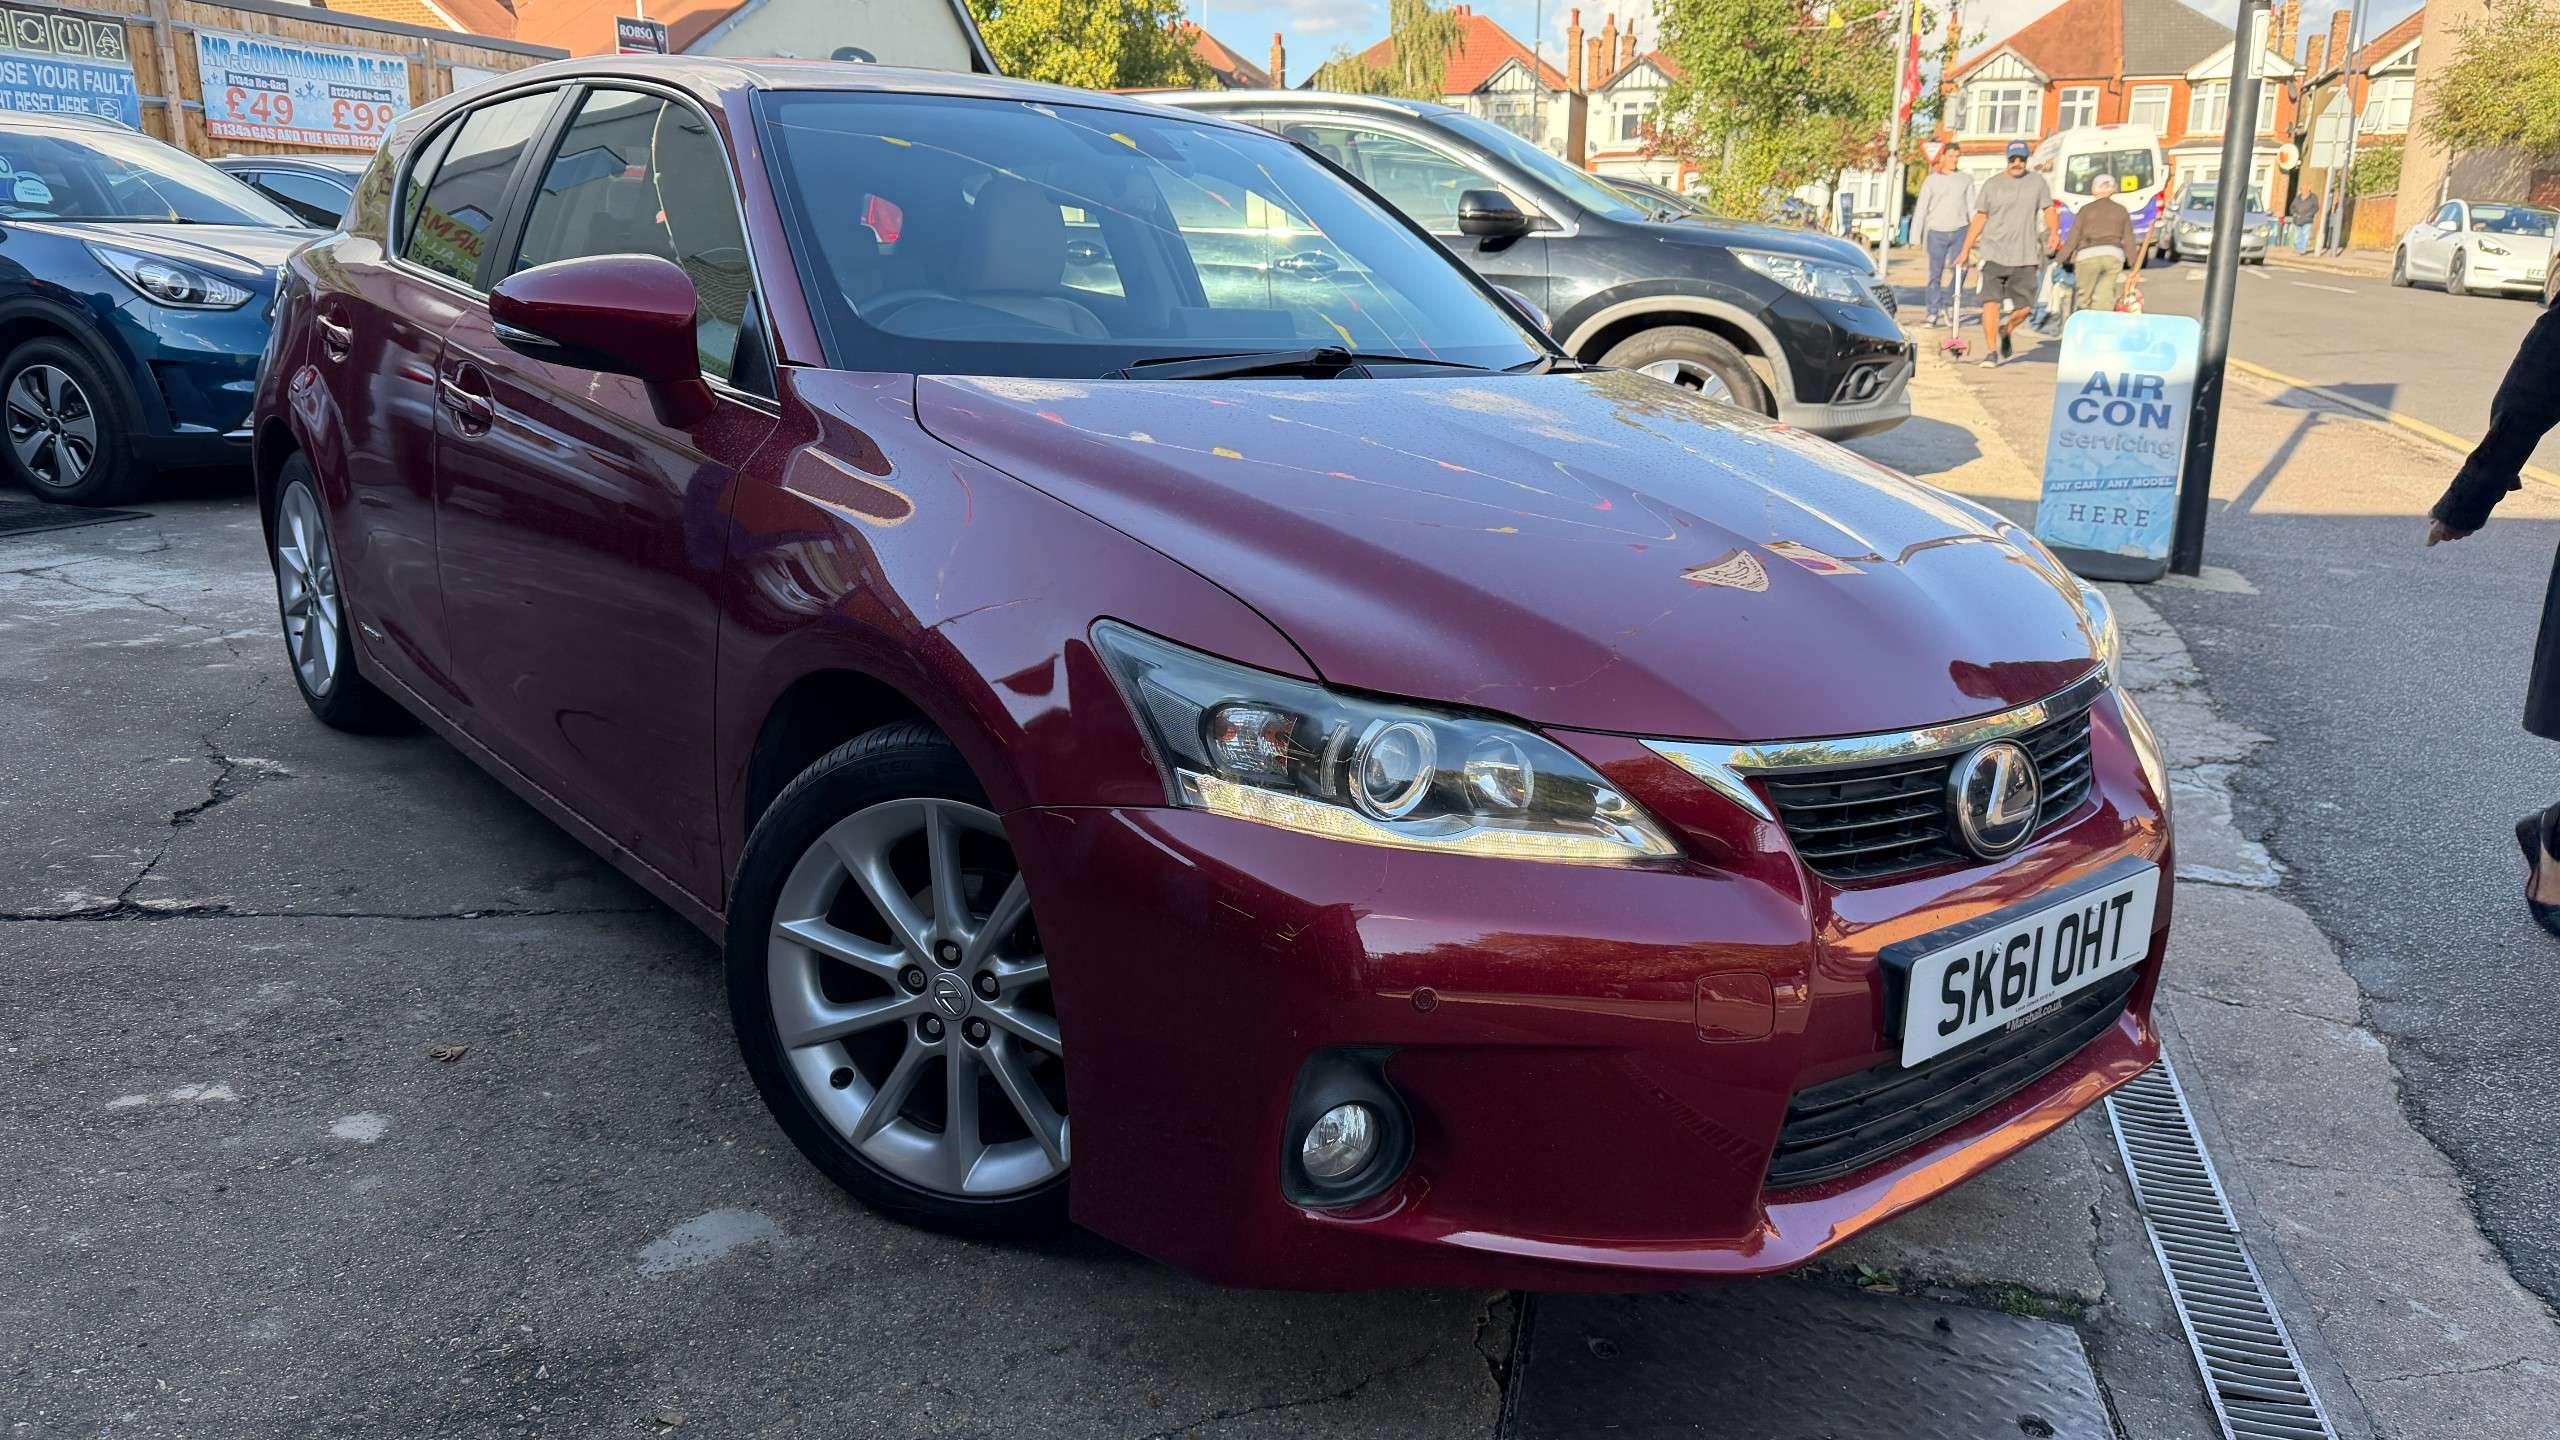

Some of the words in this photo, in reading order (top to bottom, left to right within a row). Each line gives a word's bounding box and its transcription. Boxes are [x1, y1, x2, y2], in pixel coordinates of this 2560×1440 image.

[31, 64, 80, 90] YOUR
[83, 70, 131, 95] FAULT
[15, 91, 54, 111] RESET
[57, 95, 88, 112] HERE
[225, 87, 294, 124] £49
[332, 99, 394, 131] £99
[252, 126, 276, 140] GAS
[277, 128, 300, 142] AND
[302, 131, 323, 144] THE
[324, 133, 350, 146] NEW
[2080, 371, 2165, 400] AIR
[2068, 398, 2172, 429] CON
[2058, 429, 2175, 459] Servicing
[2049, 481, 2072, 492] ANY
[2074, 480, 2097, 490] CAR
[2107, 479, 2129, 489] ANY
[2132, 477, 2174, 488] MODEL
[2068, 503, 2150, 527] HERE
[1938, 926, 2044, 1036] SK61
[2051, 890, 2133, 986] OHT
